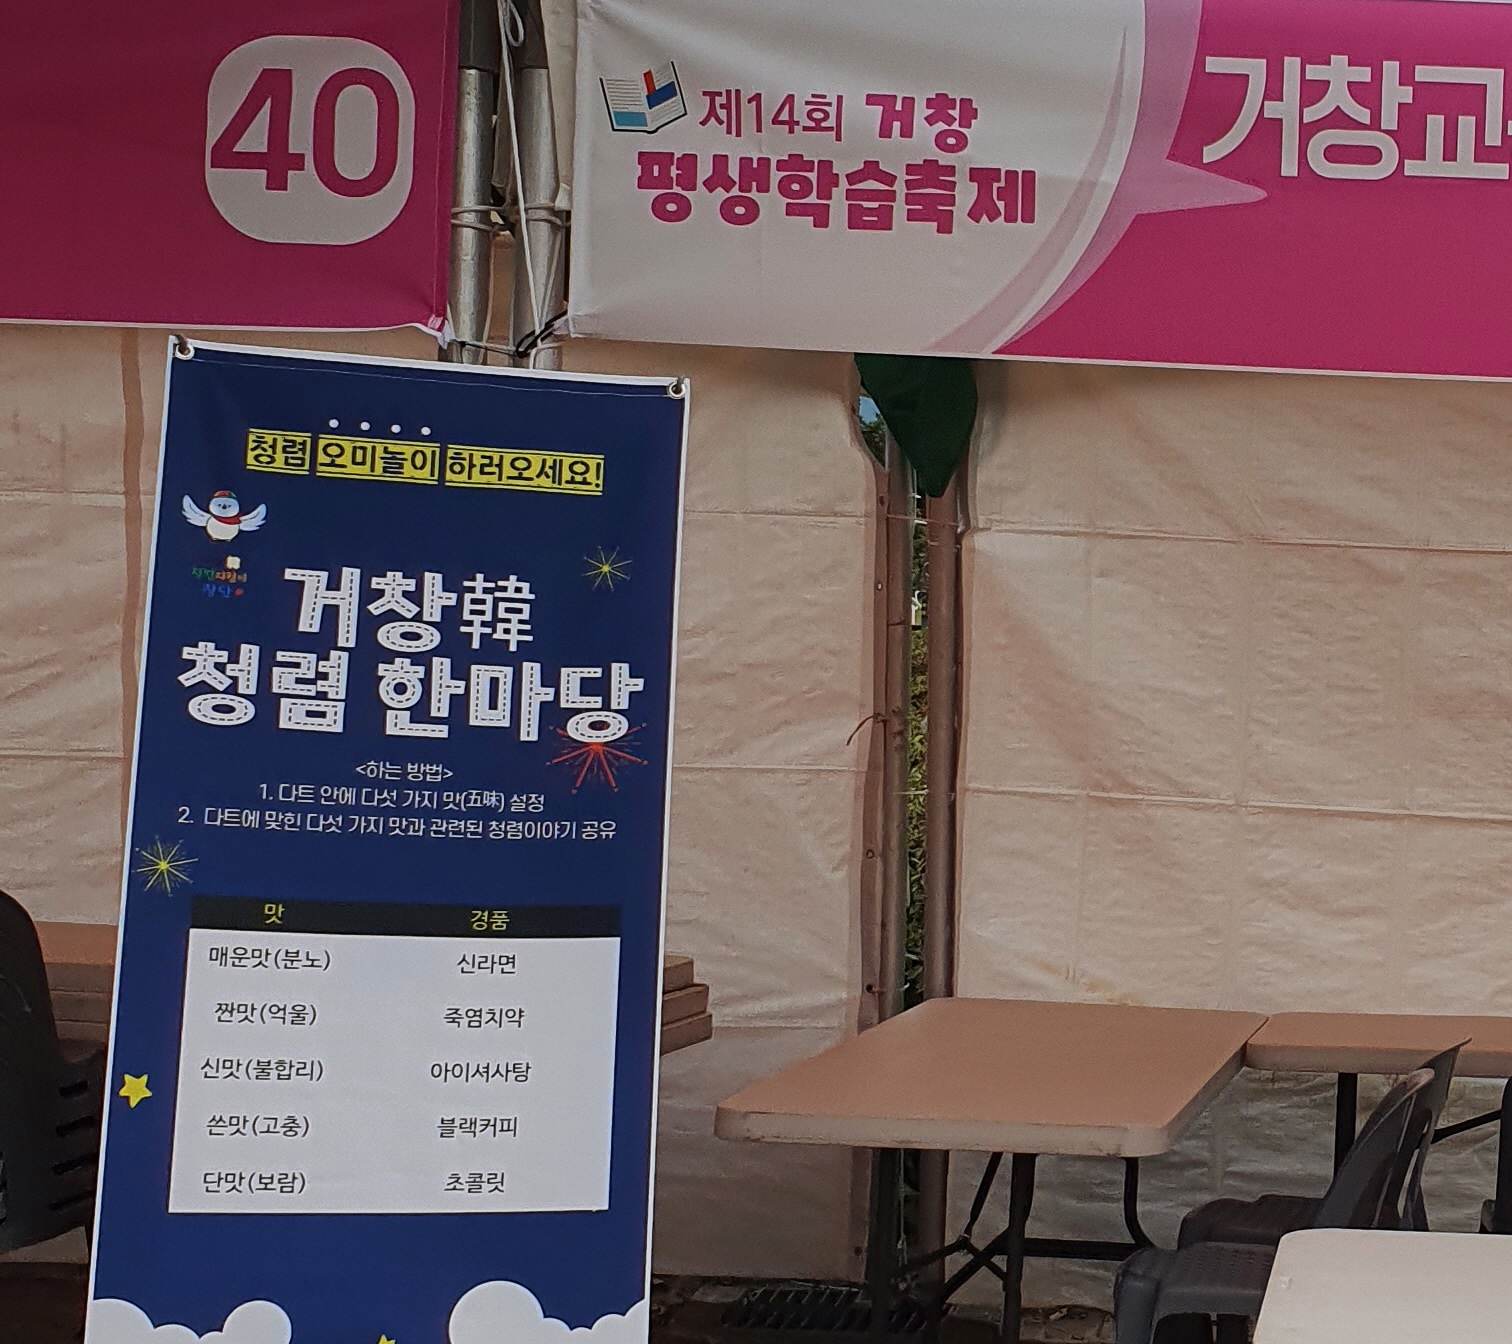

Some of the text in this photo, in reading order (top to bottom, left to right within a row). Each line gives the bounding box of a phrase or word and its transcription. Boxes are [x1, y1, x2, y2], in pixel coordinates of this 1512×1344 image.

[209, 67, 400, 198] 40
[699, 88, 978, 154] 제14회 거창
[636, 151, 1036, 234] 평생학습축제
[249, 434, 604, 490] 청렴 오미놀이 하러오세요!
[284, 567, 536, 653] 거창韓
[177, 641, 645, 743] 청렴 한마당
[355, 760, 454, 782] <하는 방법>
[259, 783, 545, 813] 1. 다트 안에 다섯 가지 맛(五味) 설정
[177, 806, 617, 840] 2. 다트에 맞힌 다섯 가지 맛과 관련된 청렴이야기 공유
[264, 903, 285, 925] 맛
[470, 909, 510, 932] 경품
[208, 946, 331, 971] 매운맛(분노)
[456, 952, 517, 975] 신라면
[214, 1001, 318, 1026] 짠맛(억울)
[443, 1006, 525, 1029] 죽염치약
[200, 1057, 324, 1082] 신맛(불합리)
[430, 1060, 532, 1084] 아이셔사탕
[206, 1114, 311, 1139] 쓴맛(고충)
[437, 1115, 518, 1139] 블랙커피
[202, 1170, 307, 1196] 단맛(보람)
[443, 1171, 506, 1194] 초콜릿
